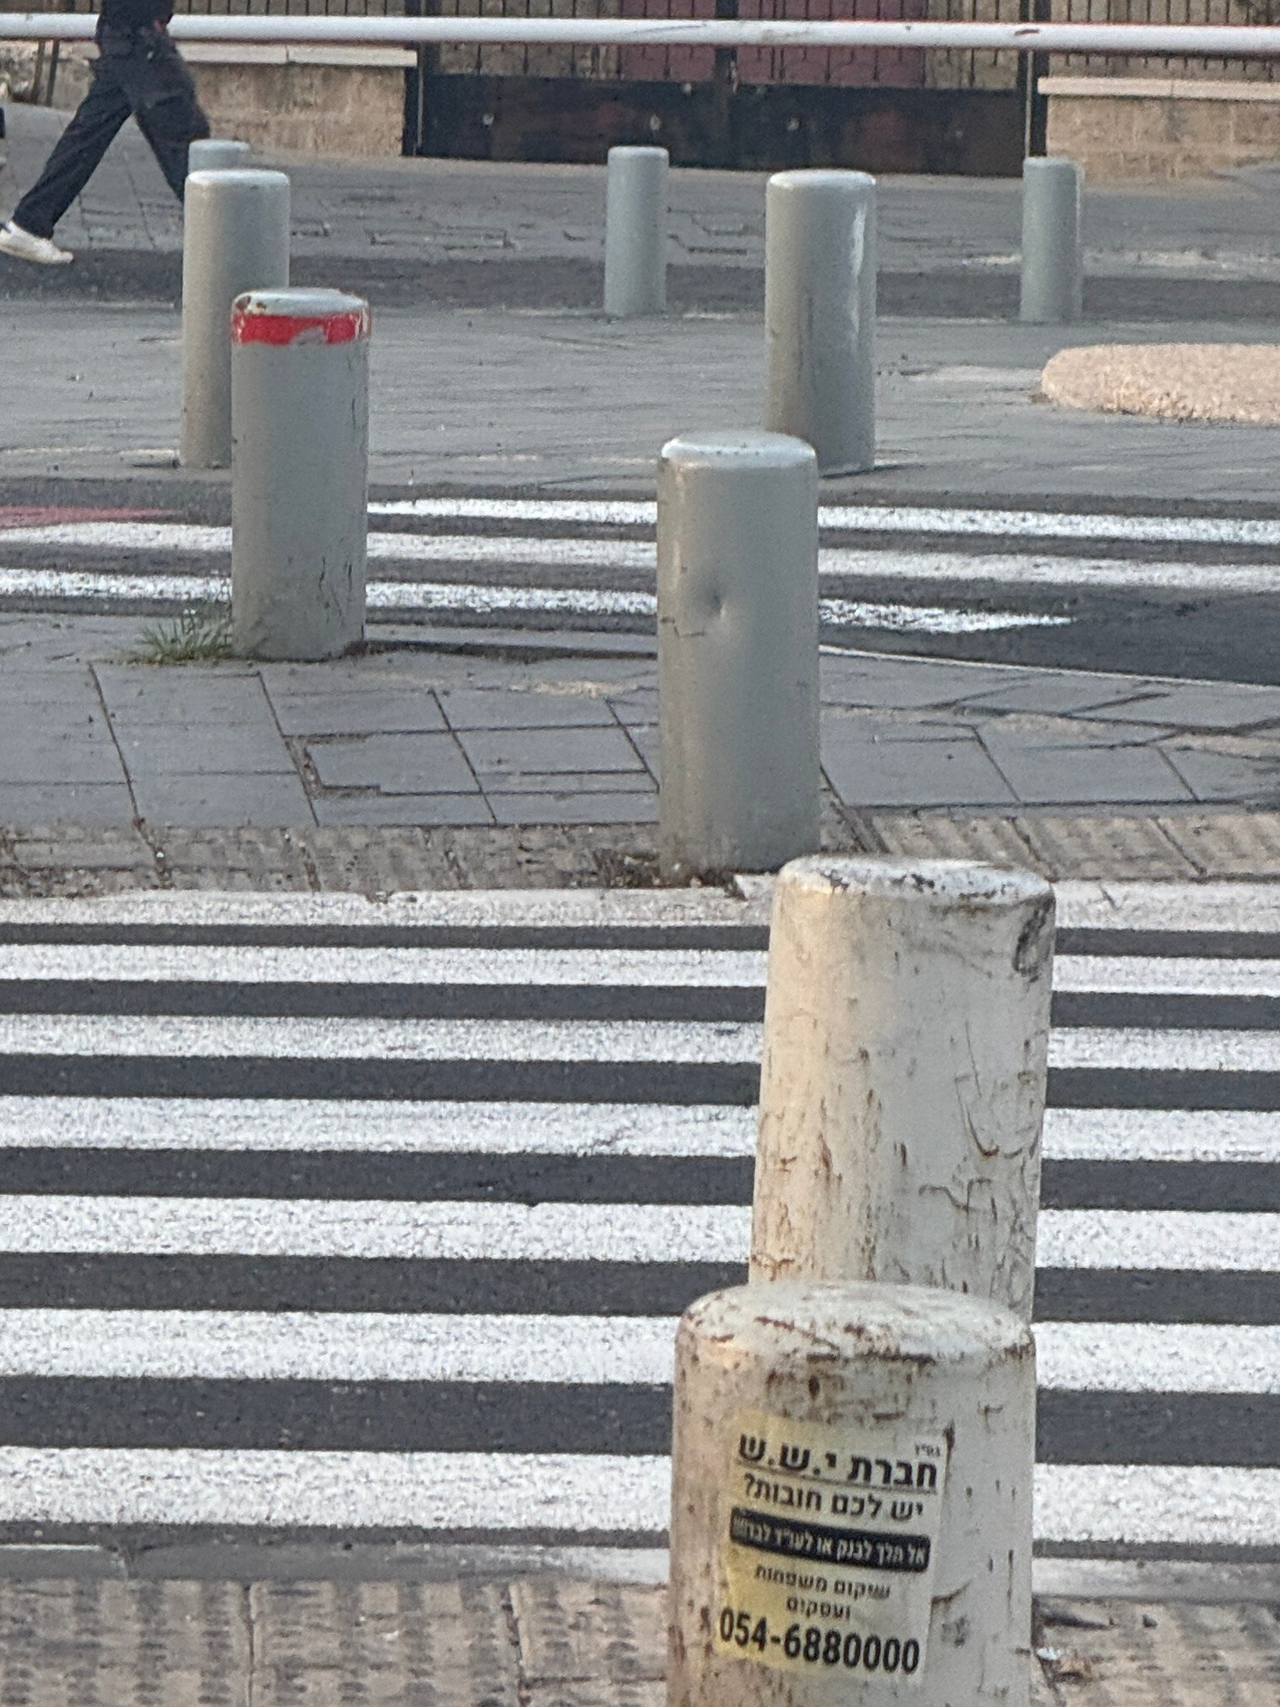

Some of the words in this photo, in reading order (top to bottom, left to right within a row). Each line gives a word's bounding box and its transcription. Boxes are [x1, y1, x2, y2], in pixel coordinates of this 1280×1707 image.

[847, 1453, 937, 1488] חברת
[744, 1473, 821, 1511] חובות?
[831, 1493, 883, 1519] לכם
[891, 1502, 923, 1521] יש
[817, 1535, 834, 1556] או
[837, 1537, 872, 1560] לבנק
[877, 1538, 903, 1566] תלך
[908, 1542, 926, 1564] אל
[755, 1563, 828, 1592] משפחות
[786, 1595, 851, 1620] ועסקים
[720, 1607, 920, 1675] 054-6880000
